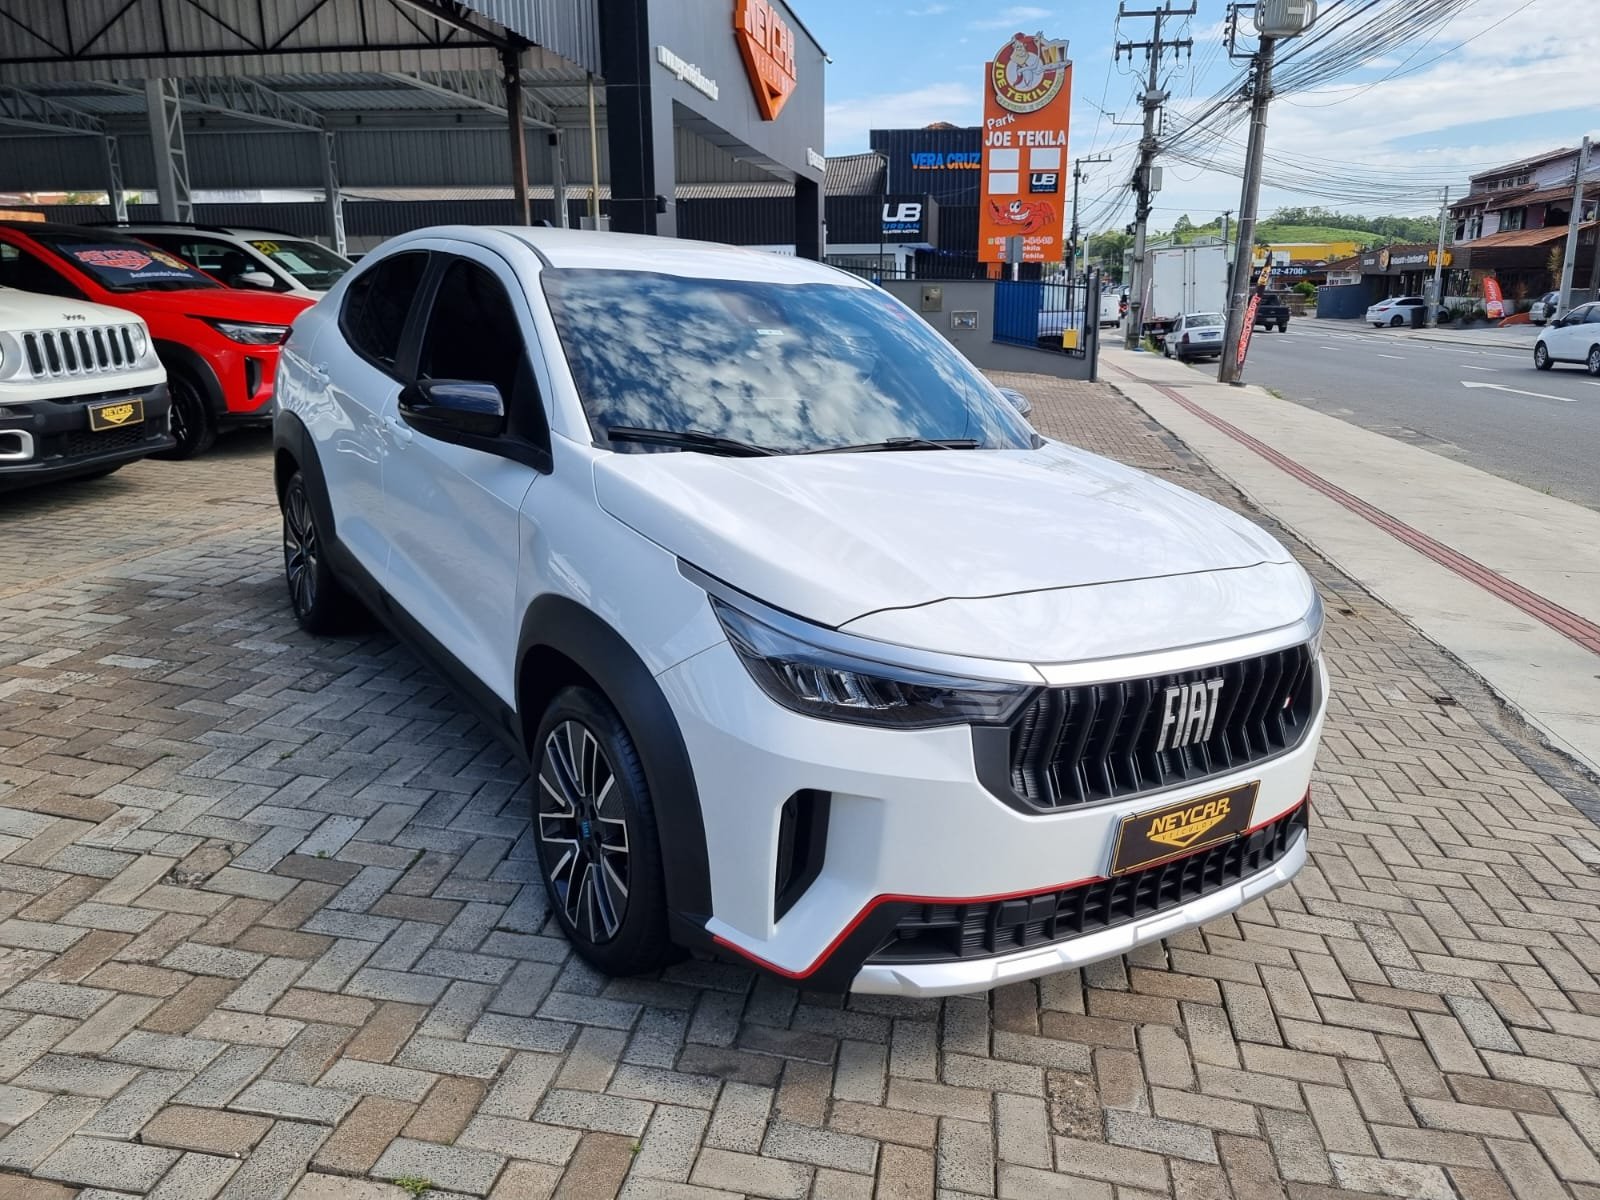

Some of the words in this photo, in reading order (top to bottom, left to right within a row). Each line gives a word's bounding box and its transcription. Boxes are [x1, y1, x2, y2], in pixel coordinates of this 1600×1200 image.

[996, 62, 1007, 89] JOE
[1007, 79, 1052, 102] TEKILA
[987, 113, 1015, 130] Park
[985, 131, 1012, 146] JOE
[1017, 130, 1066, 146] TEKILA
[911, 152, 945, 169] VERA
[947, 152, 981, 169] CRUZ
[1031, 173, 1057, 185] UB
[882, 203, 922, 222] UB
[101, 404, 134, 418] NEYCAR
[1156, 679, 1224, 752] FIAT
[1147, 797, 1231, 837] NEYCAR
